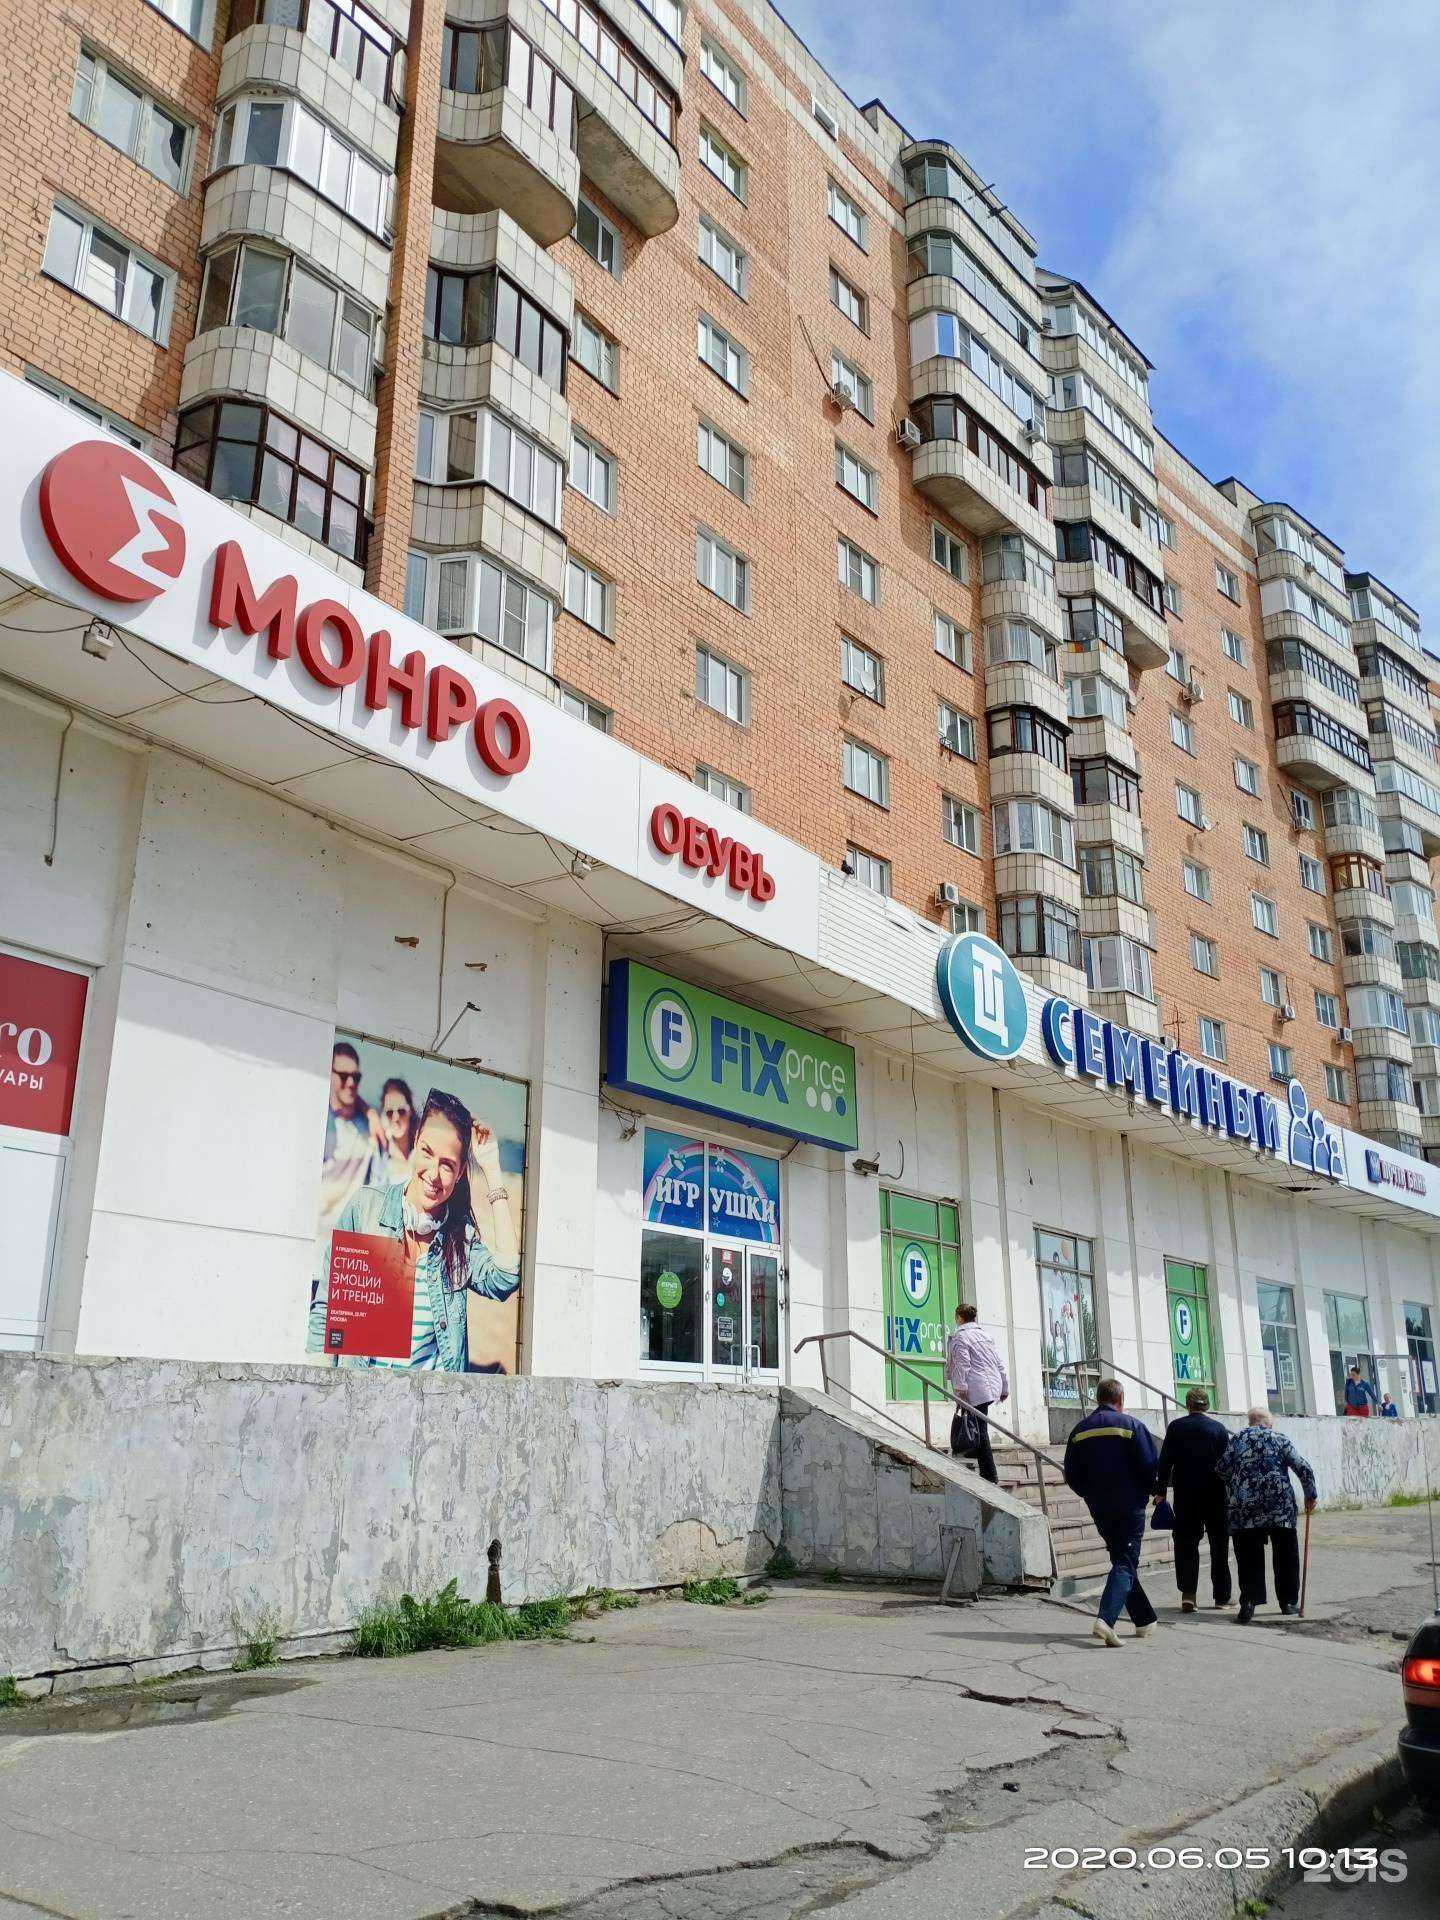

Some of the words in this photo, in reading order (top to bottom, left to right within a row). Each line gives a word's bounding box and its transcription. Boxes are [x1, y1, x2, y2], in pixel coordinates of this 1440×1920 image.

[208, 539, 531, 776] МОНРО
[651, 802, 776, 902] ОБУВЬ
[1042, 996, 1283, 1153] СЕМЕЙНЫЙ
[332, 1272, 382, 1289] ЭМОЦИИ
[333, 1256, 371, 1273] СТИЛЬ,
[331, 1290, 340, 1300] И
[343, 1289, 385, 1306] ТРЕНДЫ
